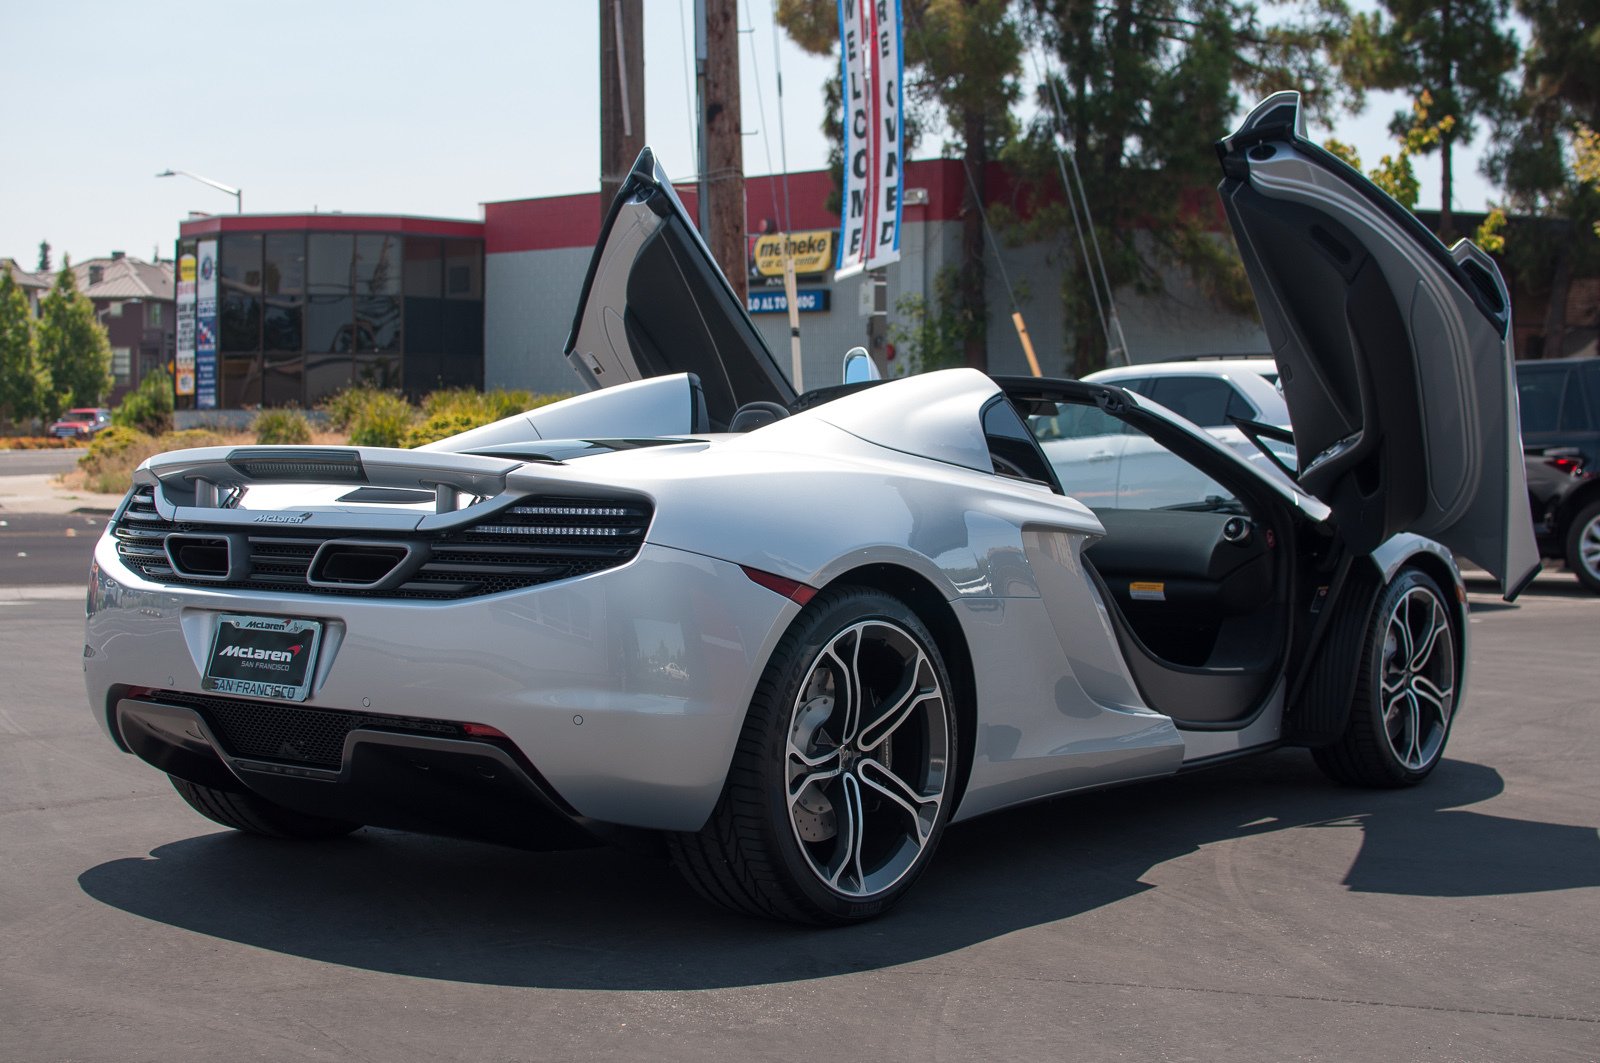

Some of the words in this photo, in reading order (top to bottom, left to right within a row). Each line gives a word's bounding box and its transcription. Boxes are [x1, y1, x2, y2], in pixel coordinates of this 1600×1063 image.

[760, 236, 826, 256] meineke
[766, 278, 784, 287] AN
[761, 297, 787, 310] ALTO
[254, 514, 304, 524] McLaren
[245, 620, 285, 631] McLaren
[219, 645, 293, 662] McLaren
[241, 660, 254, 668] SAN
[255, 662, 290, 672] FRANCISCO
[214, 678, 233, 691] SAN
[235, 681, 296, 699] FRANCISCO
